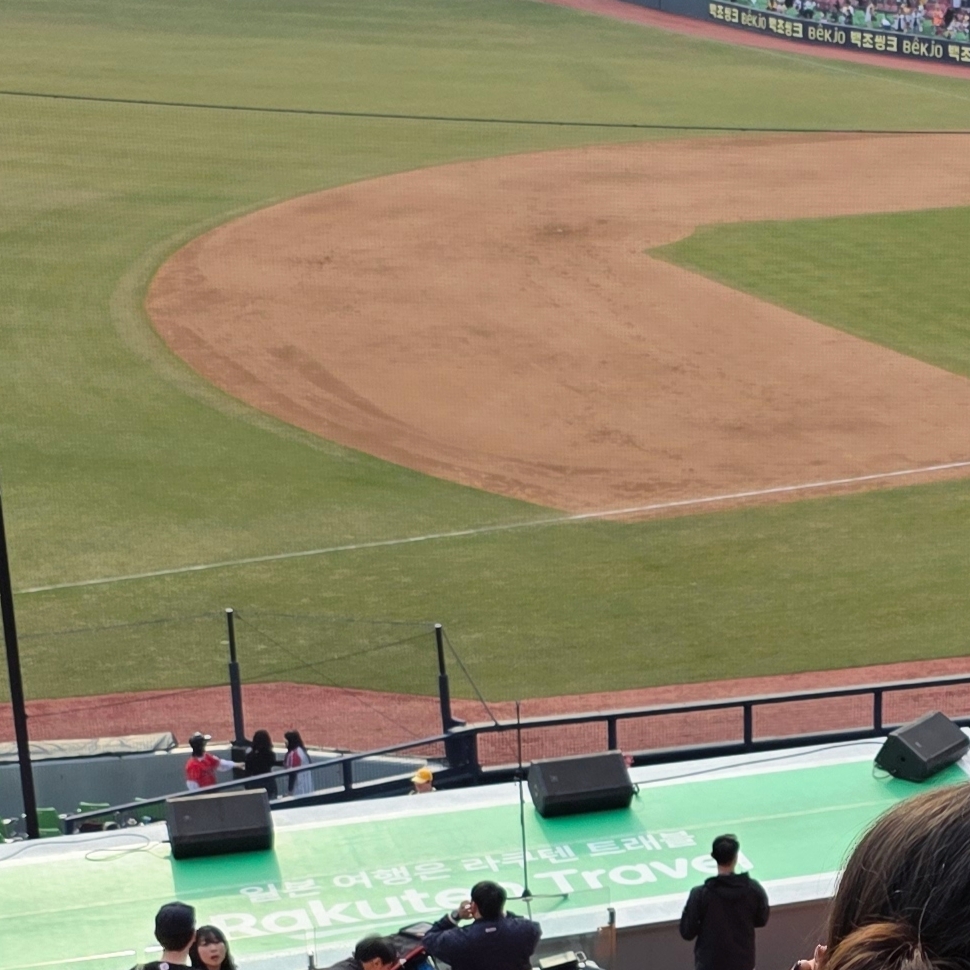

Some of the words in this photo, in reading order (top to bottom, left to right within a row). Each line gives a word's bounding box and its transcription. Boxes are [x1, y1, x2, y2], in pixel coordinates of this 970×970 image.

[768, 16, 803, 38] 백조씽크
[850, 31, 898, 52] 백조씽크
[240, 879, 321, 904] 일본
[333, 862, 450, 889] 여행은
[461, 844, 579, 874] 라쿠텐
[586, 829, 698, 858] 트래블
